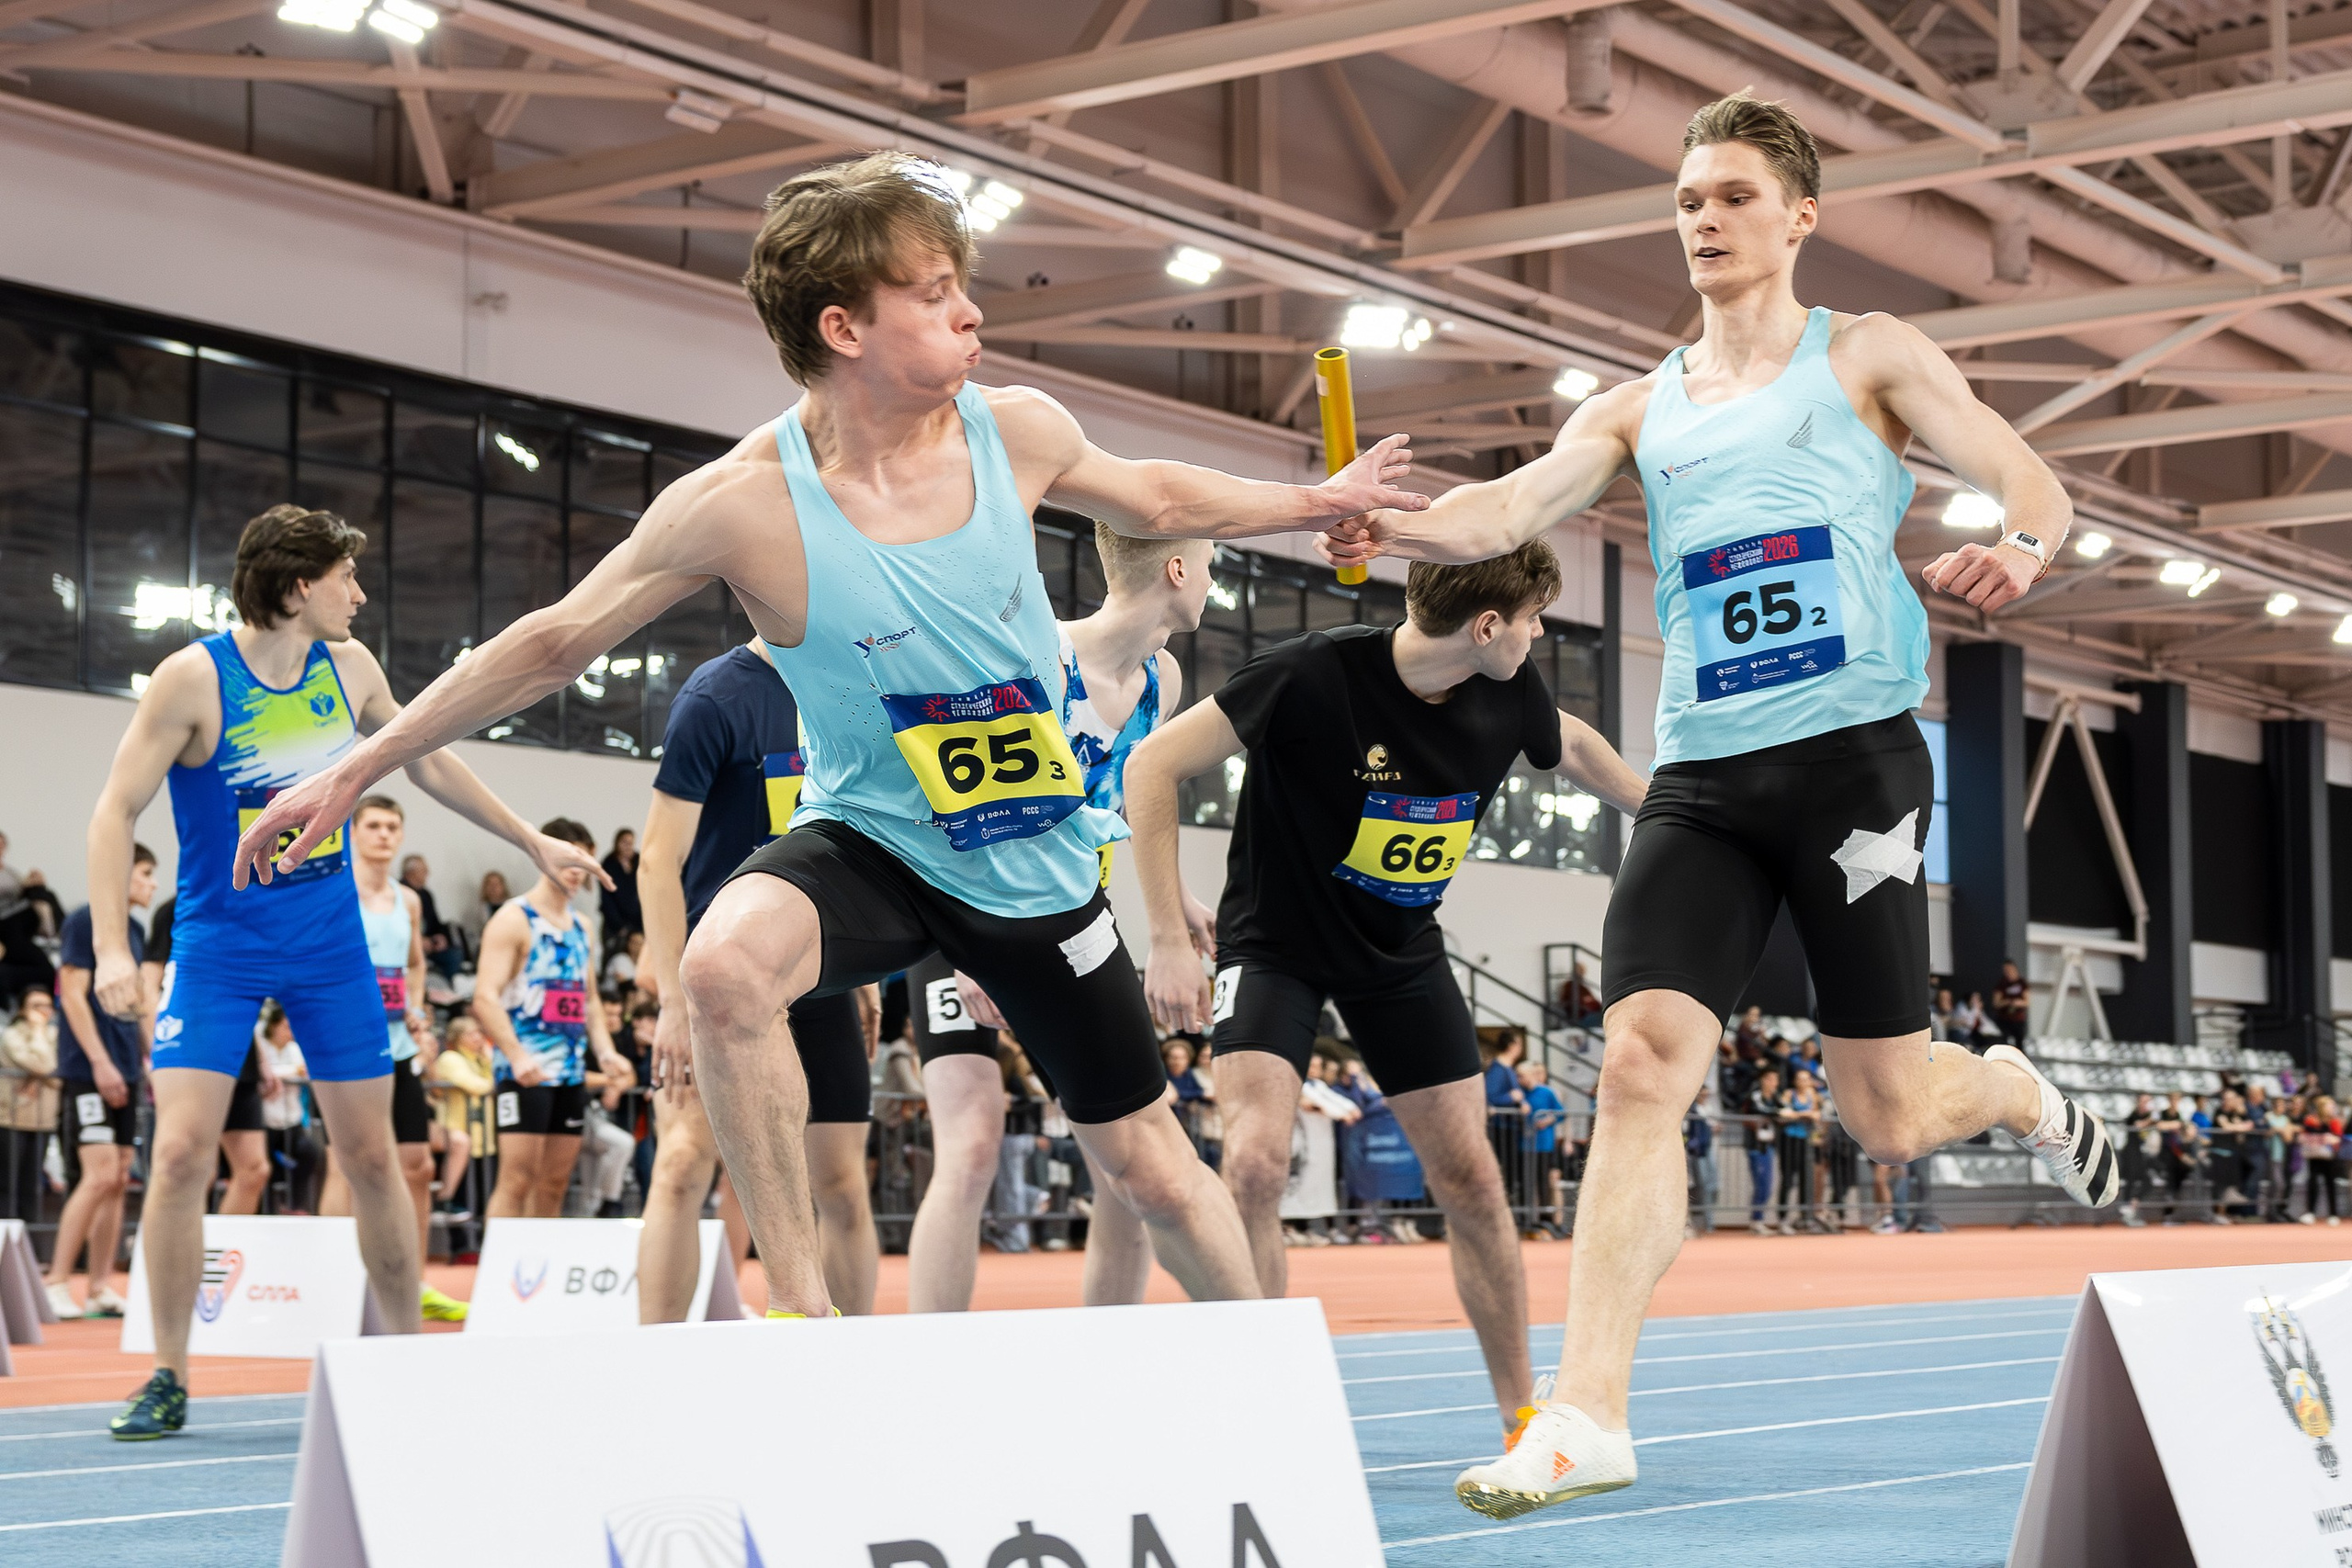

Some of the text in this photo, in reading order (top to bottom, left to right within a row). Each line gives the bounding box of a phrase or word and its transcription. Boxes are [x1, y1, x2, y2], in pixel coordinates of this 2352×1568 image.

[1762, 534, 1800, 562] 2026
[1723, 580, 1828, 645] 65 2
[938, 728, 1067, 795] 65 3
[987, 808, 1012, 819] ВФЛА
[1381, 833, 1455, 874] 66 3
[940, 987, 962, 1021] 5
